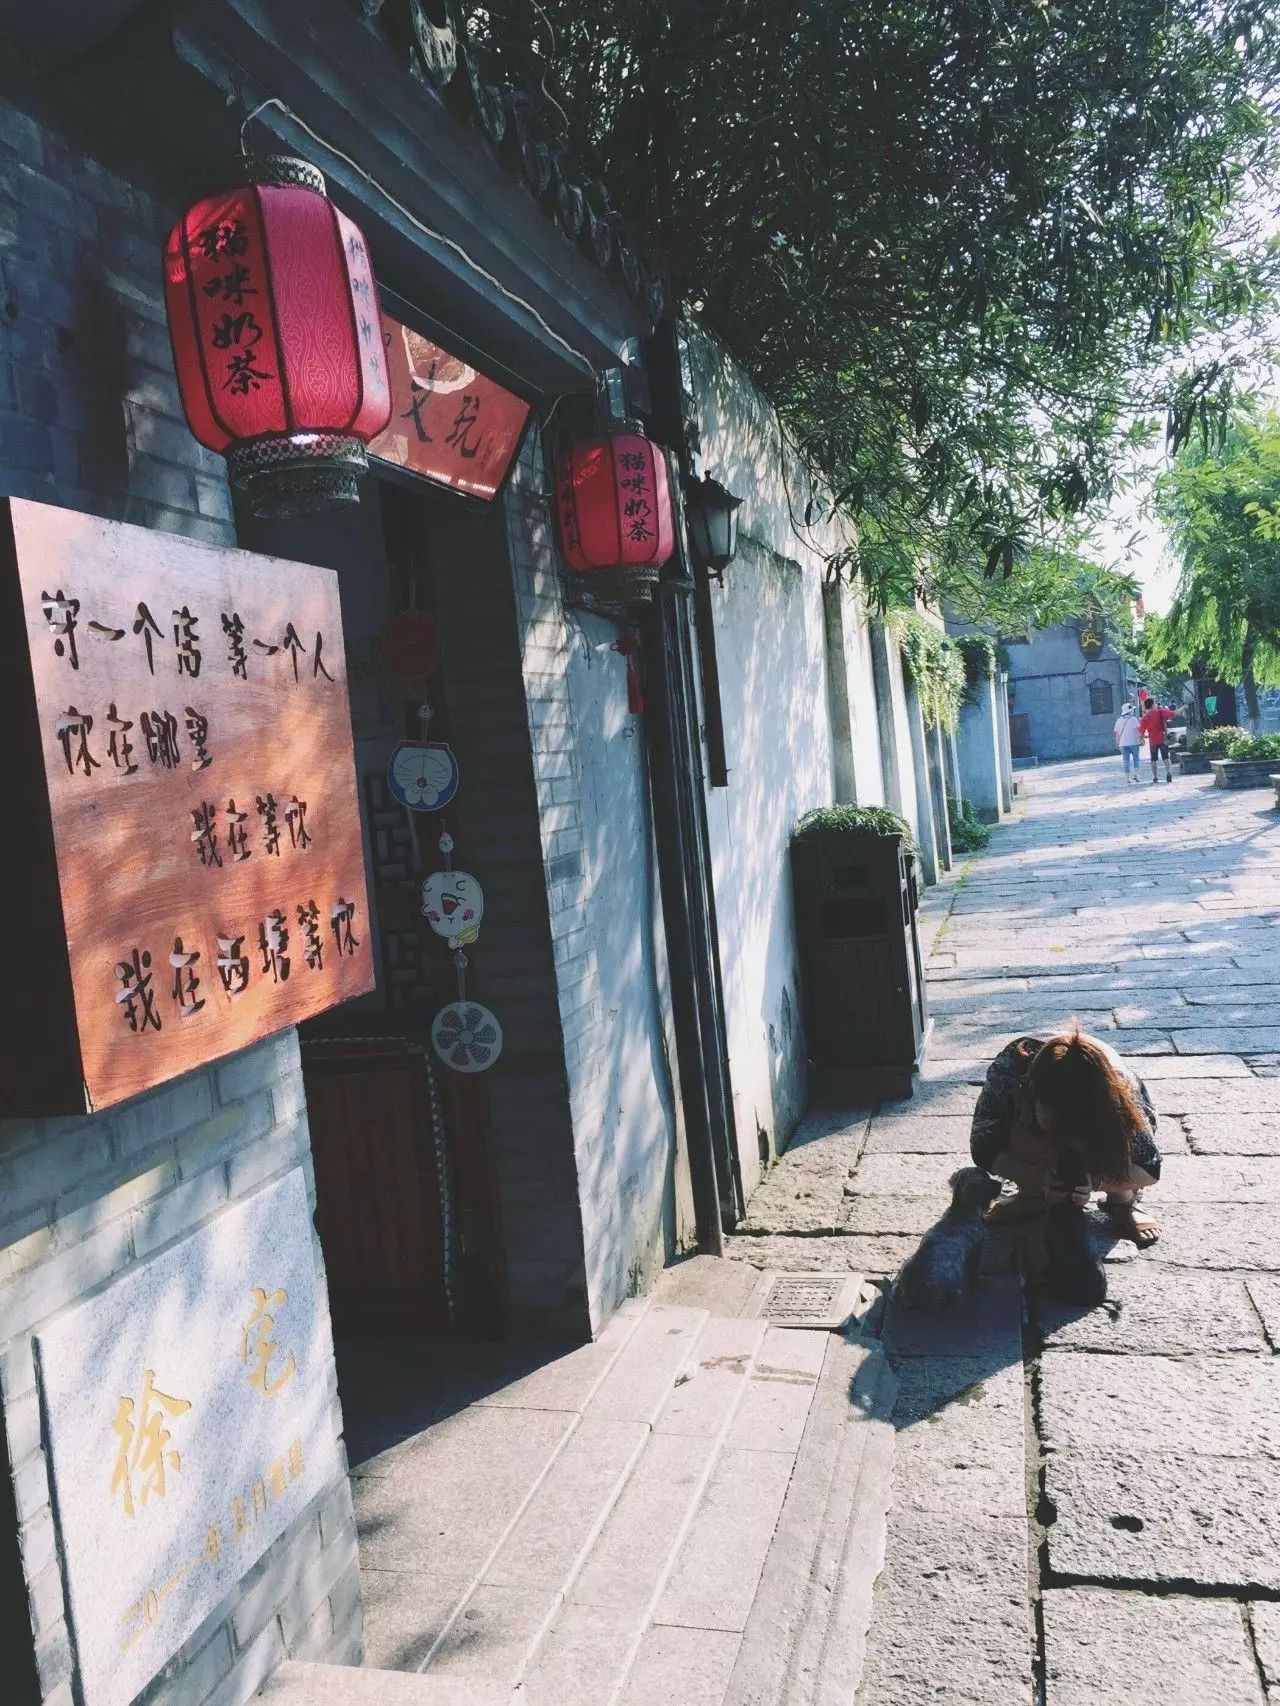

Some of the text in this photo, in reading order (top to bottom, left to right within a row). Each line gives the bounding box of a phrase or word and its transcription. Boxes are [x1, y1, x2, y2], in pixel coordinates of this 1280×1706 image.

[55, 703, 214, 777] 你在哪里
[191, 792, 312, 868] 我在等你
[114, 897, 360, 1033] 我在西塘等你
